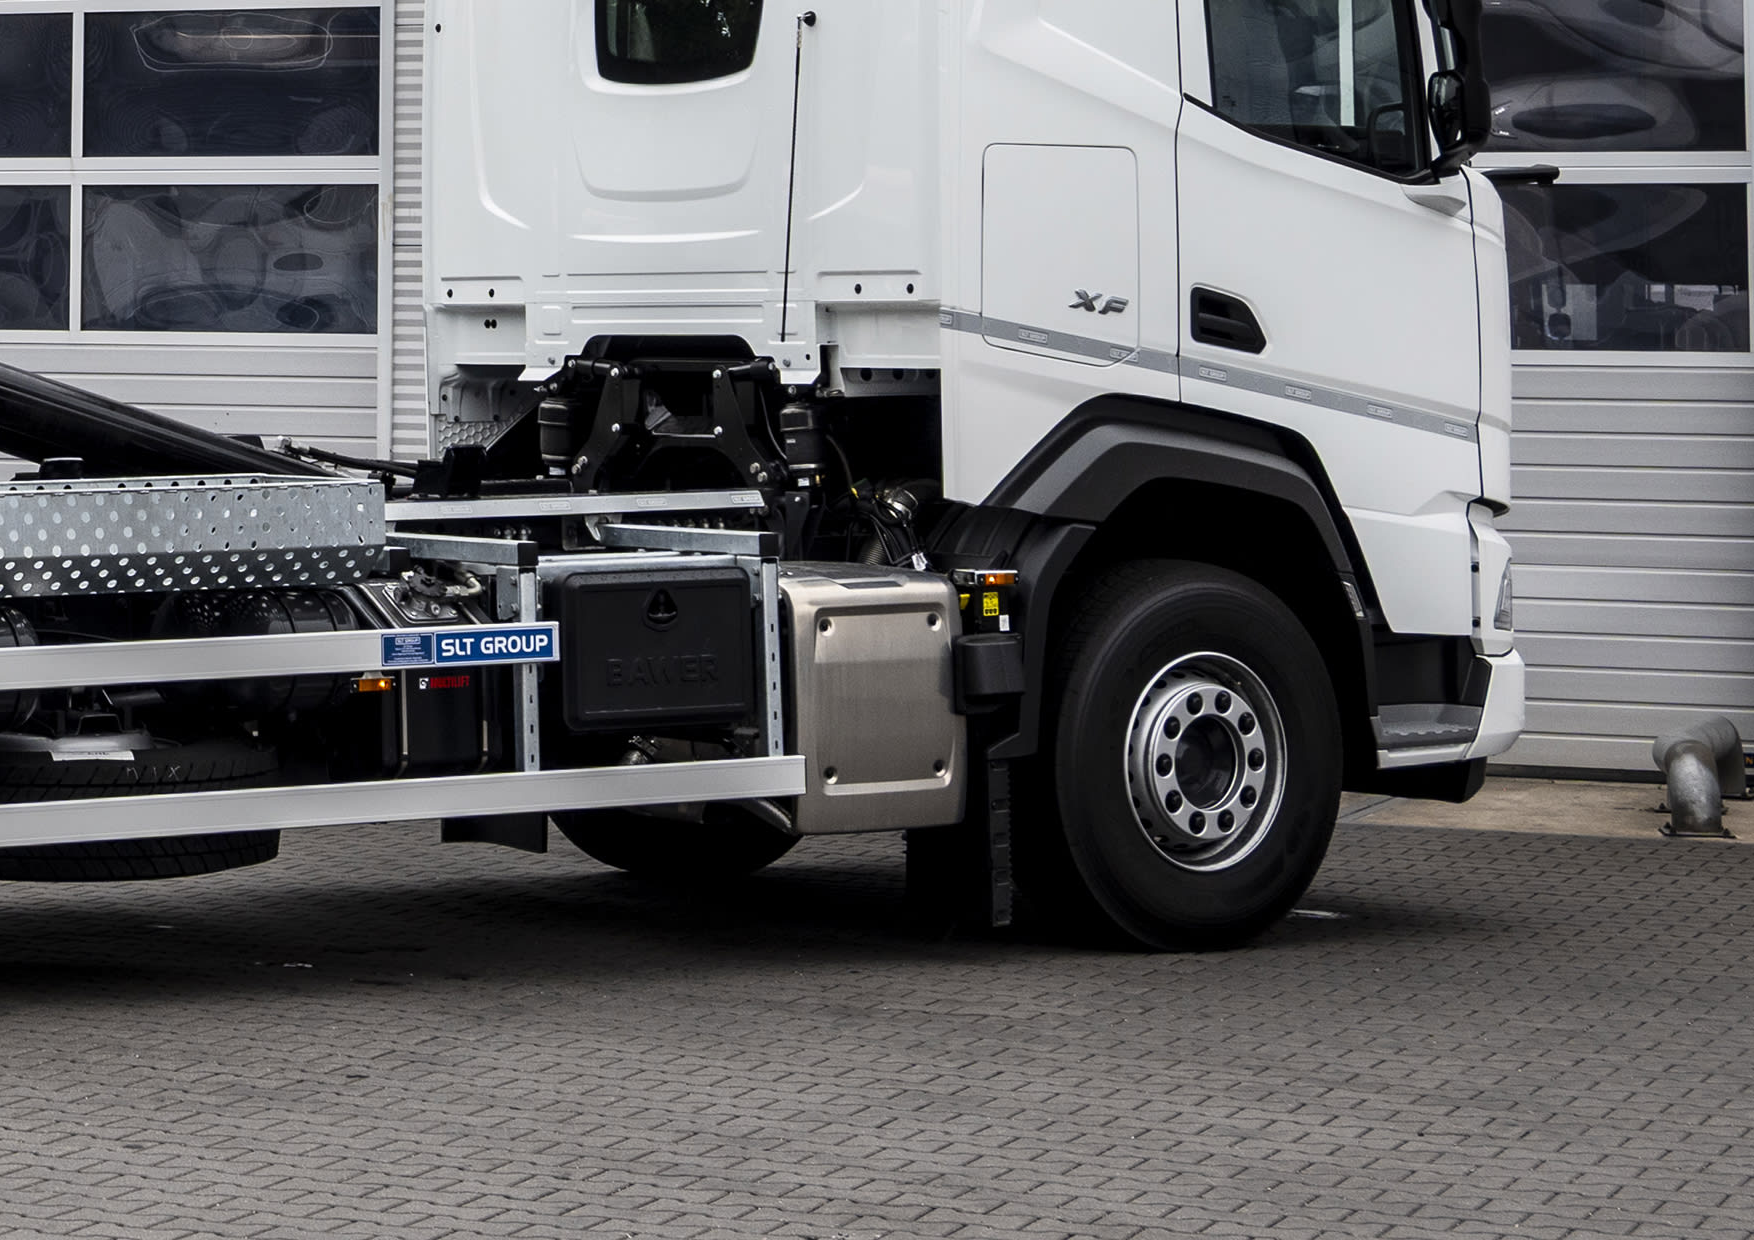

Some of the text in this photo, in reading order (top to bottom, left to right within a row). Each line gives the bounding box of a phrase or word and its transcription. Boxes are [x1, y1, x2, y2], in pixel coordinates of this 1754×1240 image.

[1068, 288, 1129, 315] XF
[441, 638, 475, 657] SLT
[480, 635, 549, 655] GROUP
[430, 675, 471, 689] MULTILIFT
